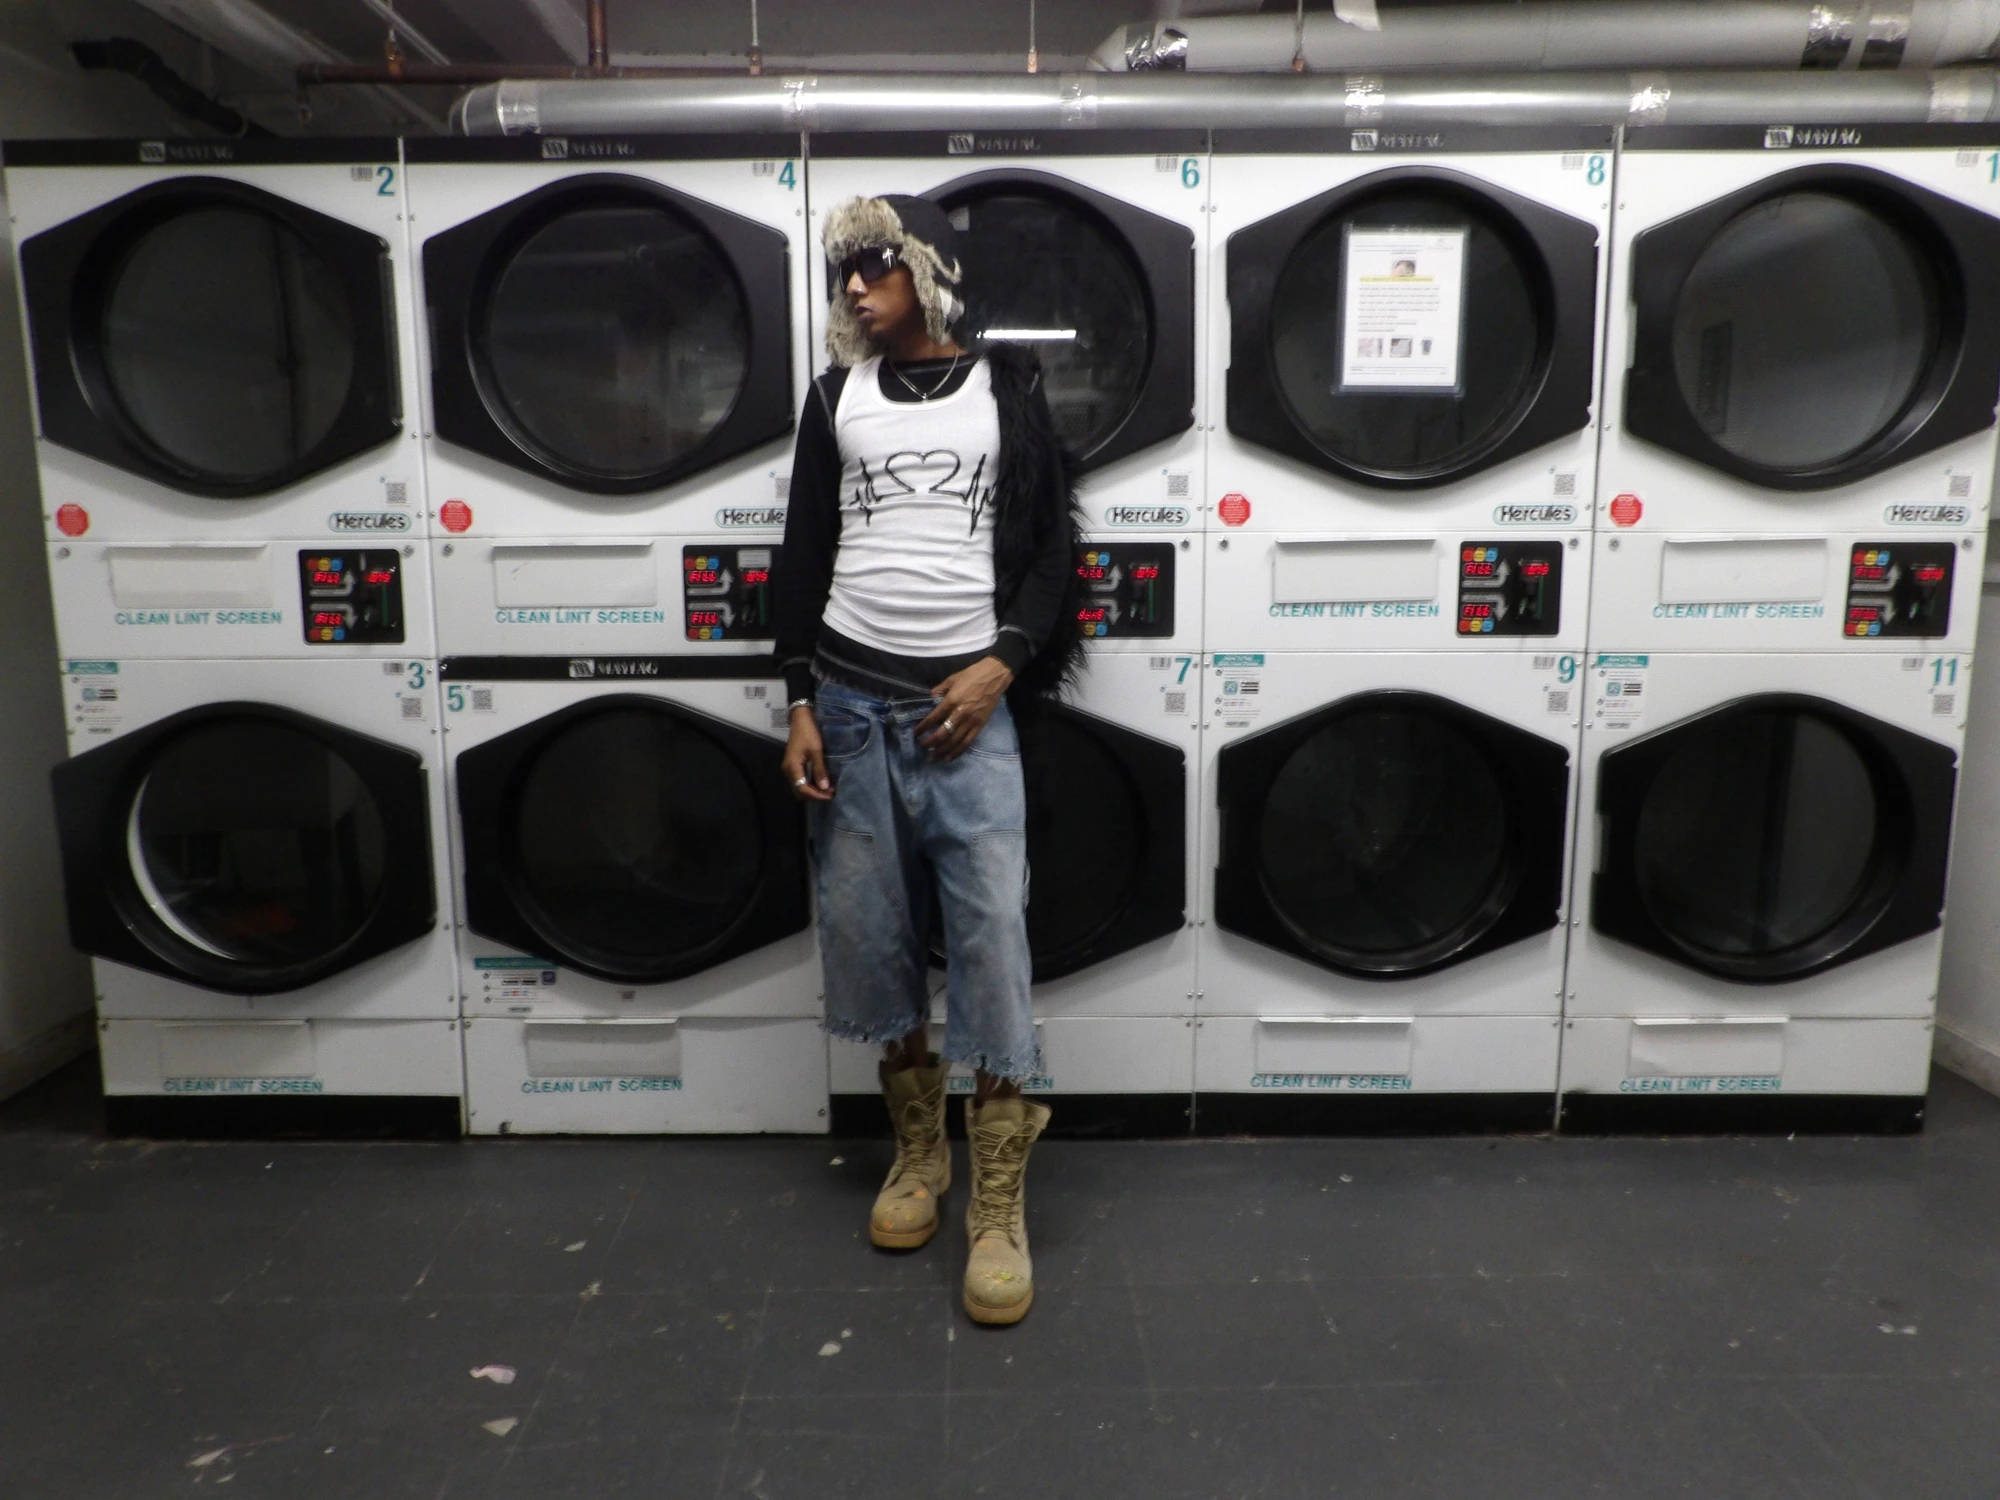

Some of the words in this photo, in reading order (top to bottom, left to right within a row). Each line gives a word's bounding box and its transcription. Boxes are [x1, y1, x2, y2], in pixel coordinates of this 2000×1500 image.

[778, 162, 796, 191] 4
[1182, 158, 1199, 189] 6
[1587, 155, 1605, 186] 8
[378, 166, 395, 196] 2
[335, 513, 406, 529] Hercules
[723, 508, 786, 525] Hercule
[1112, 507, 1183, 523] Hercules
[1500, 505, 1571, 521] Hercules
[1890, 505, 1964, 522] Hercules
[115, 612, 169, 625] CLEAN
[175, 611, 209, 625] LINT
[216, 611, 282, 625] SCREEN
[496, 611, 550, 623] CLEAN
[556, 611, 590, 623] LINT
[597, 611, 664, 623] SCREEN
[1269, 604, 1323, 618] CLEAN
[1330, 604, 1365, 617] LINT
[1372, 603, 1439, 617] SCREEN
[1653, 606, 1707, 618] CLEAN
[1713, 605, 1748, 618] LINT
[1755, 605, 1823, 618] SCREEN
[407, 662, 425, 690] 3
[1175, 657, 1192, 685] 7
[1558, 655, 1576, 684] 9
[1930, 658, 1958, 686] 11
[447, 685, 464, 713] 5
[164, 1080, 215, 1092] CLEAN
[220, 1080, 254, 1092] LINT
[260, 1080, 323, 1093] SCREEN
[522, 1081, 574, 1093] CLEAN
[579, 1080, 612, 1092] LINT
[618, 1079, 682, 1091] SCREEN
[1250, 1075, 1303, 1088] CLEAN
[1308, 1075, 1341, 1088] LINT
[1347, 1076, 1412, 1090] SCREEN
[1619, 1080, 1672, 1092] CLEAN
[1678, 1079, 1711, 1092] LINT
[1717, 1079, 1781, 1092] SCREEN
